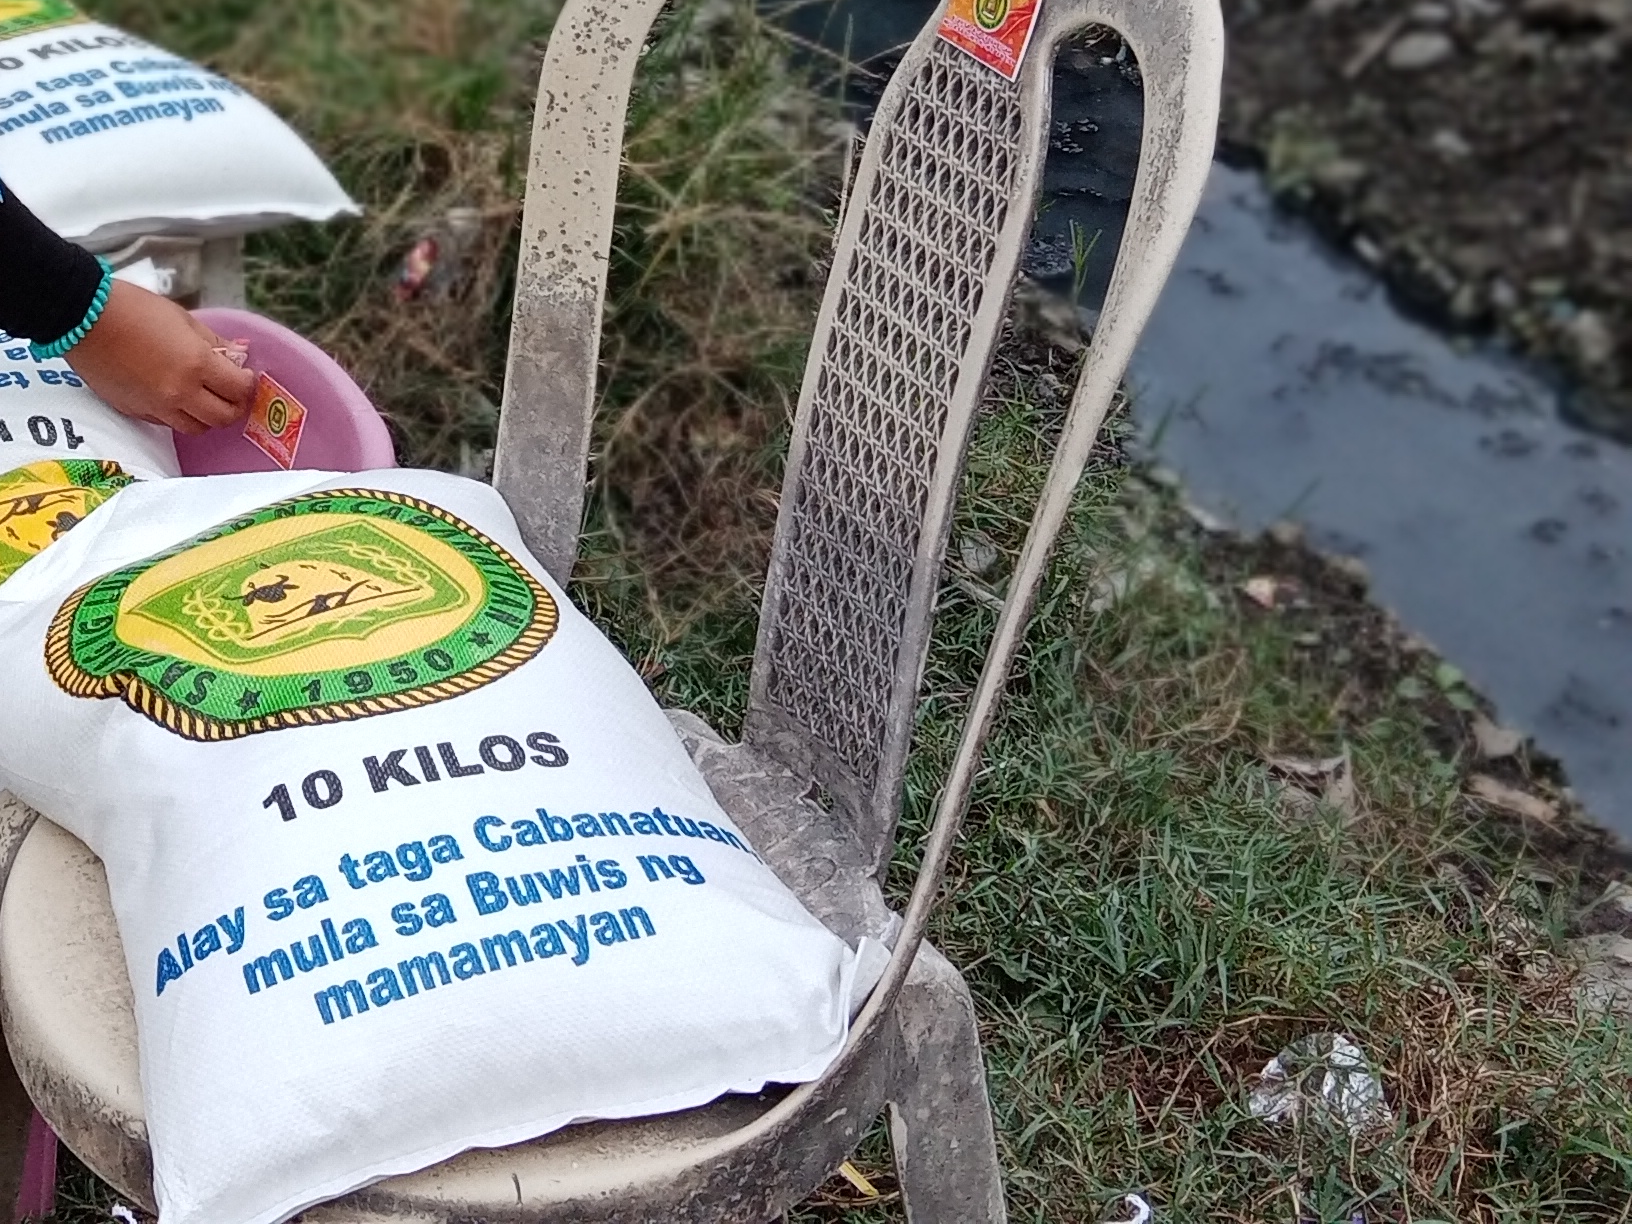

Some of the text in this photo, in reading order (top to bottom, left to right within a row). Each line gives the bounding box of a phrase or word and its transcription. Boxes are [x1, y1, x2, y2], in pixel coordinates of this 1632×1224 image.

[35, 68, 110, 94] taga
[75, 89, 115, 109] sa
[114, 76, 205, 98] Buwis
[39, 96, 226, 145] mamamayan
[36, 368, 84, 388] sa
[27, 414, 85, 451] 10
[274, 499, 333, 520] NG
[350, 500, 530, 631] CABANATUAN
[303, 647, 455, 702] 1950
[262, 731, 571, 823] 10 KILOS
[155, 905, 247, 996] Alay
[262, 874, 330, 922] sa
[338, 829, 464, 891] taga
[241, 854, 706, 995] mula sa Buwis ng
[313, 905, 657, 1025] mamamayan
